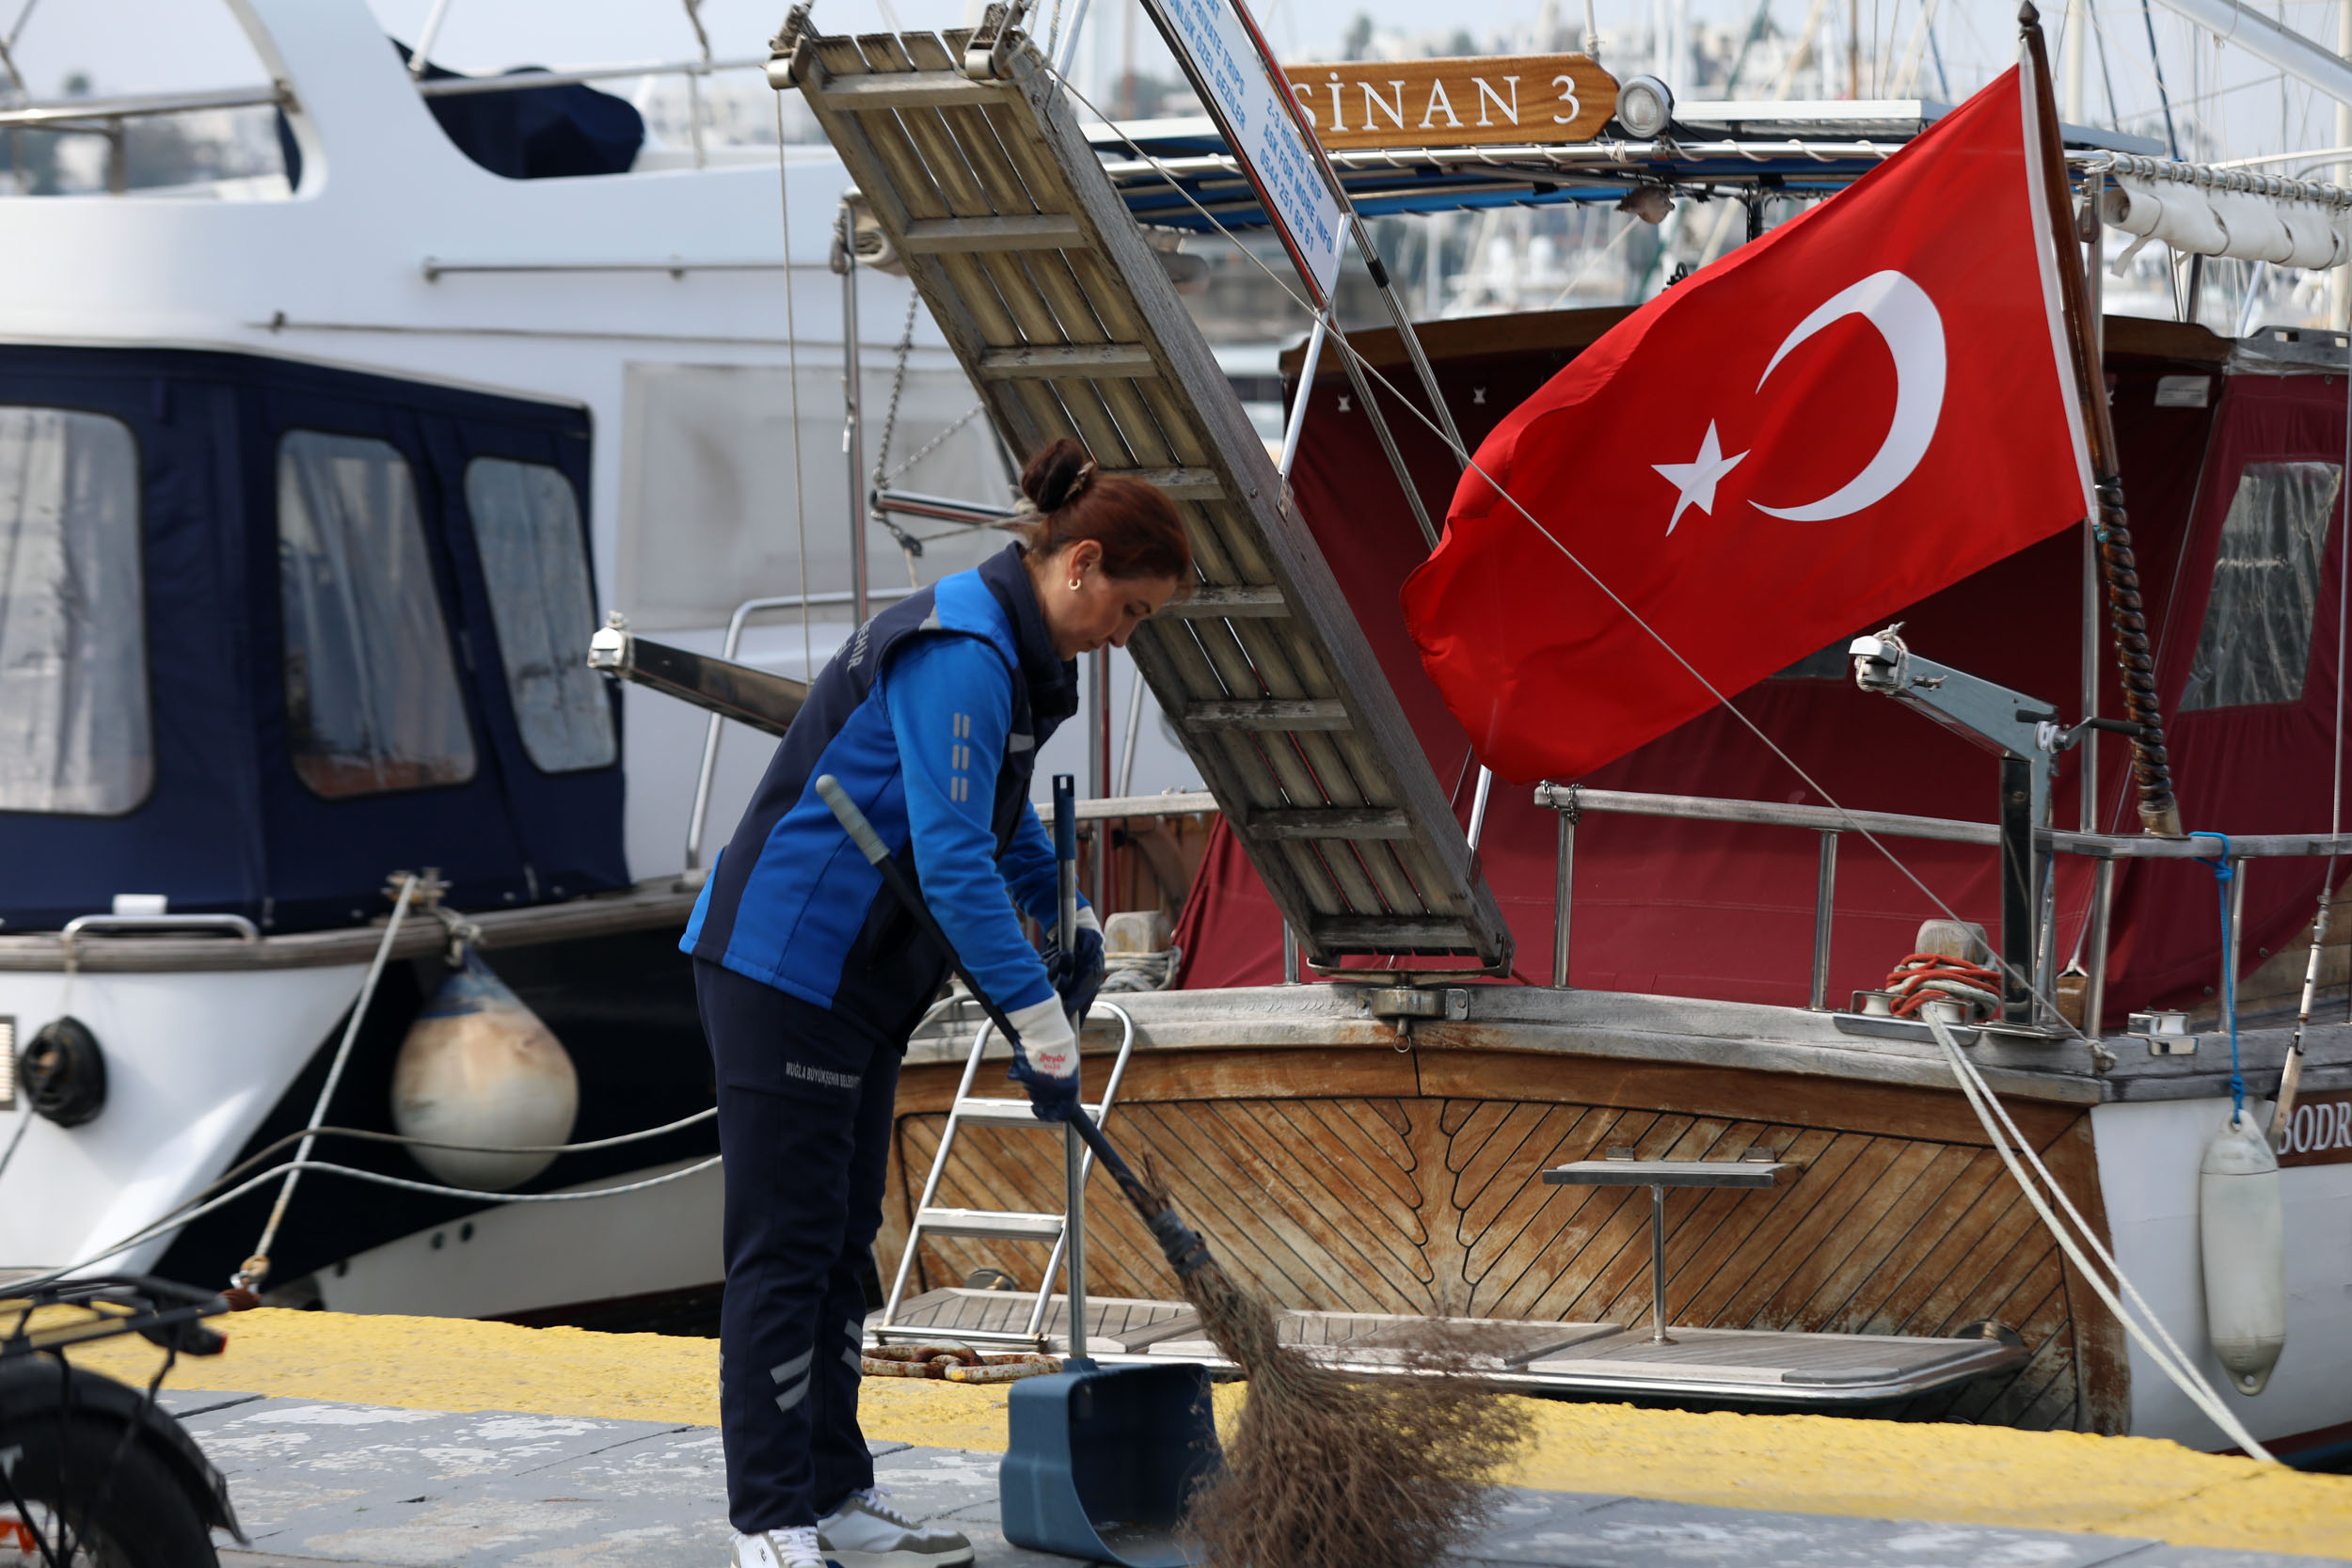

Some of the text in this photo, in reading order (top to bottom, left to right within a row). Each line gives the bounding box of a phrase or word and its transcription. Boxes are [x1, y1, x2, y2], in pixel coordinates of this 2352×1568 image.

[1196, 31, 1214, 77] ÖZEL
[1216, 69, 1246, 131] GEZİLER
[1224, 48, 1245, 96] TRIPS
[1551, 74, 1581, 125] 3
[1260, 148, 1314, 252] 0544 251 66 61
[1263, 123, 1332, 254] ASK FOR MORE INFO
[1280, 122, 1305, 174] HOURS
[1306, 166, 1322, 201] TRIP
